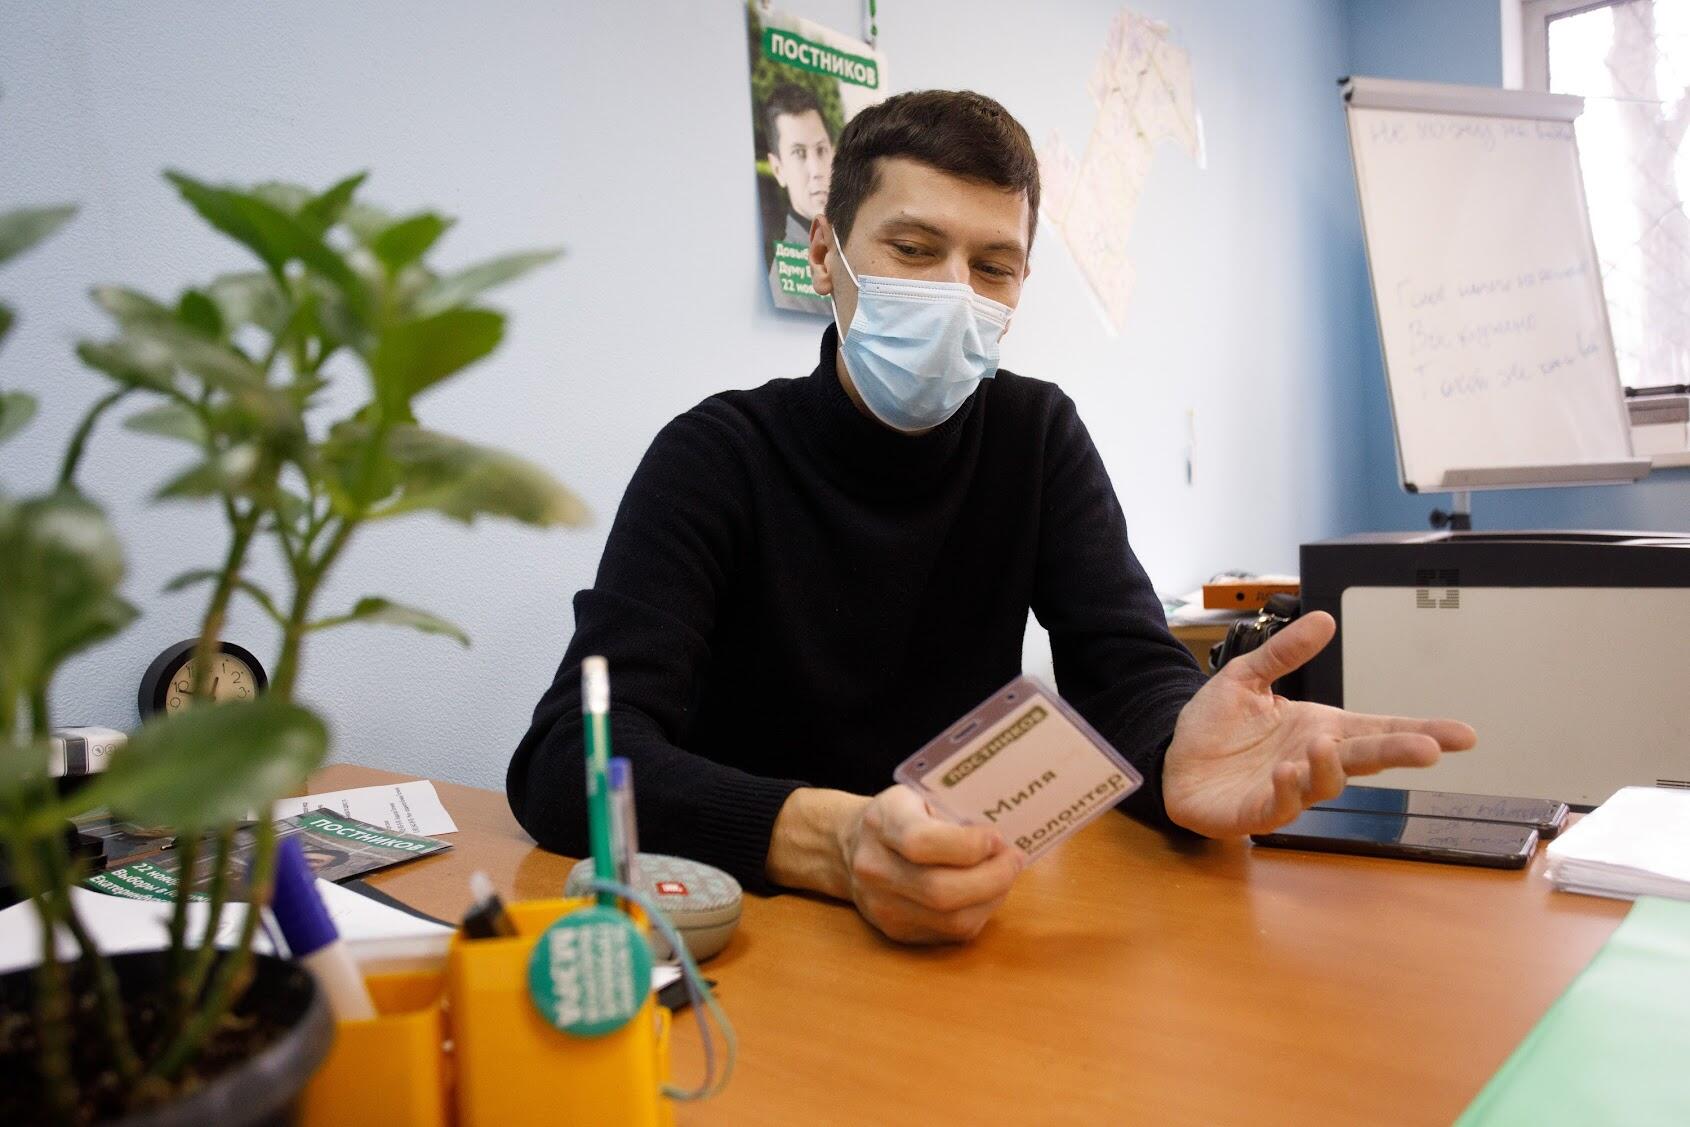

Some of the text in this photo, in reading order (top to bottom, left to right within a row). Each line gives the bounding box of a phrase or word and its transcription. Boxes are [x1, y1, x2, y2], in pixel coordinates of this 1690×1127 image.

[771, 33, 877, 86] ПОСТНИКОВ
[776, 243, 809, 260] Довыб
[779, 260, 806, 279] Думу
[781, 278, 796, 291] 22
[174, 680, 190, 693] 10
[231, 671, 242, 684] 2
[238, 686, 248, 698] 3
[983, 770, 1057, 822] Миля
[1014, 773, 1122, 850] Волонтер
[310, 818, 425, 850] ПОСТНИКОВ
[132, 862, 154, 873] 22
[111, 868, 159, 892] Выборы
